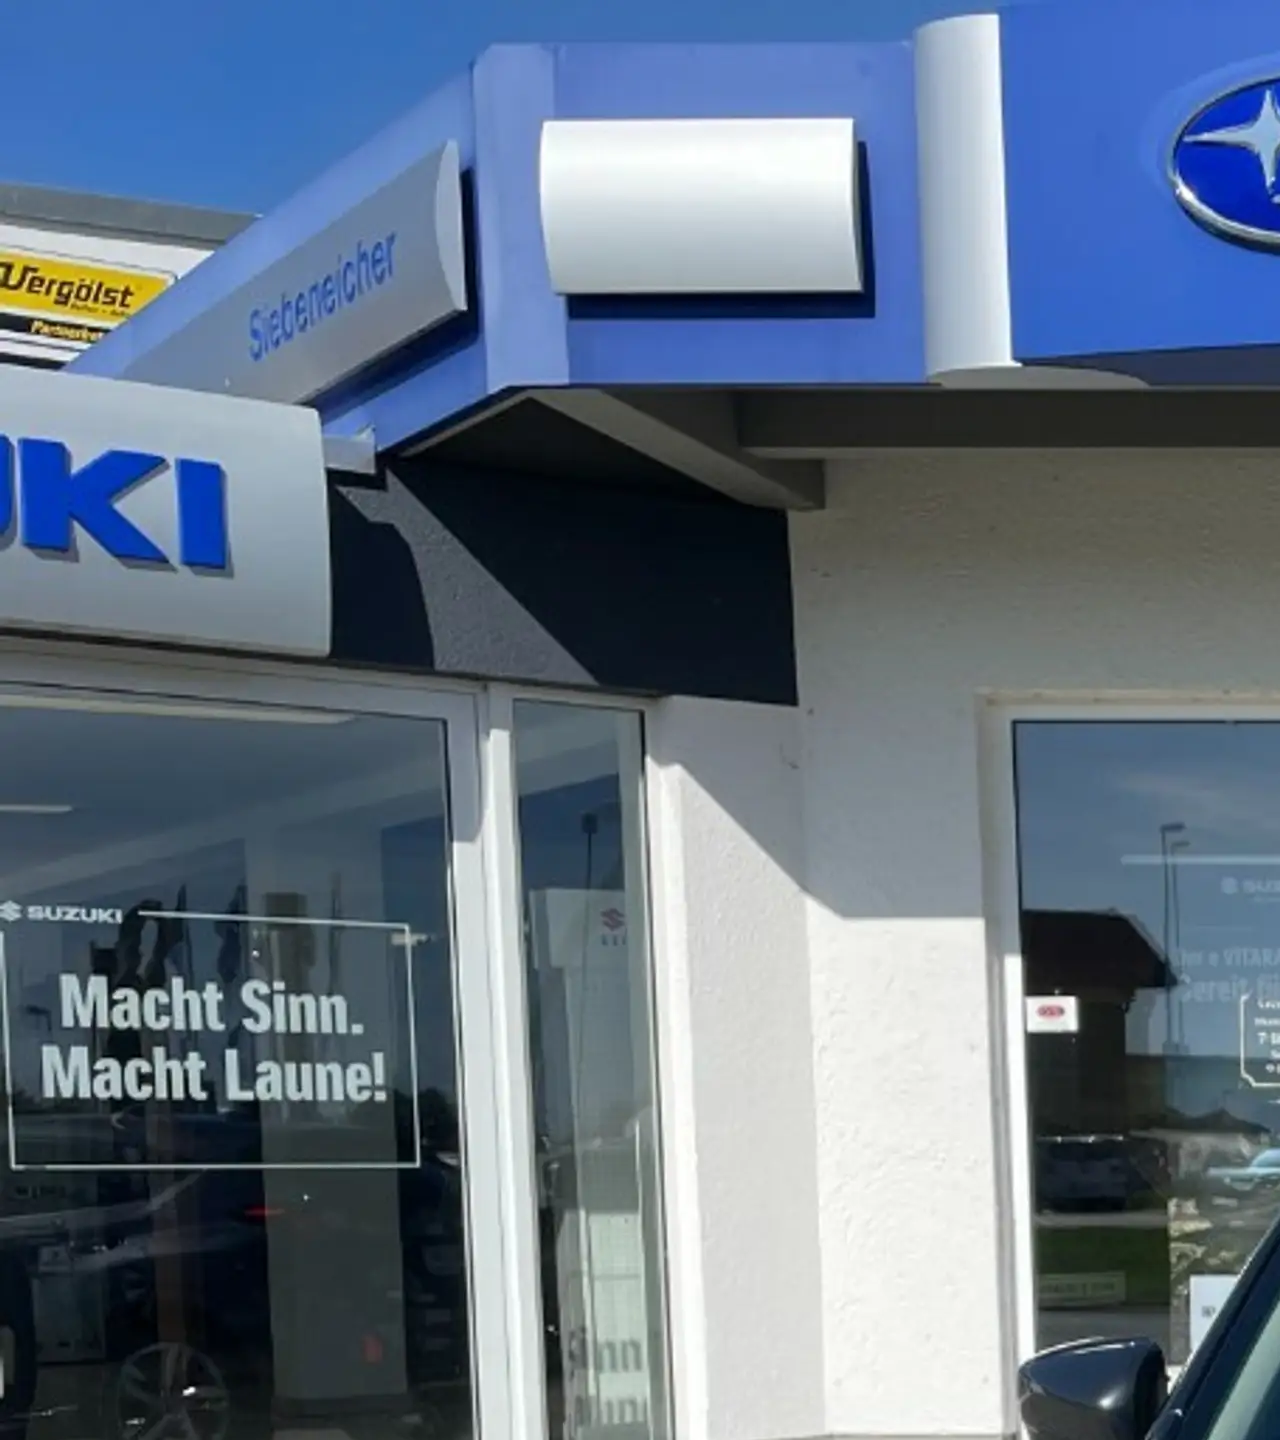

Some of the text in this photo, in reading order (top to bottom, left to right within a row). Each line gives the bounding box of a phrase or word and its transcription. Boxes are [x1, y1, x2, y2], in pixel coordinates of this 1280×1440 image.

[0, 262, 135, 308] Vergölst
[248, 232, 398, 362] Siebeneicher
[27, 904, 123, 924] SUZUKI
[59, 972, 365, 1035] Macht Sinn.
[41, 1044, 387, 1102] Macht Laune!
